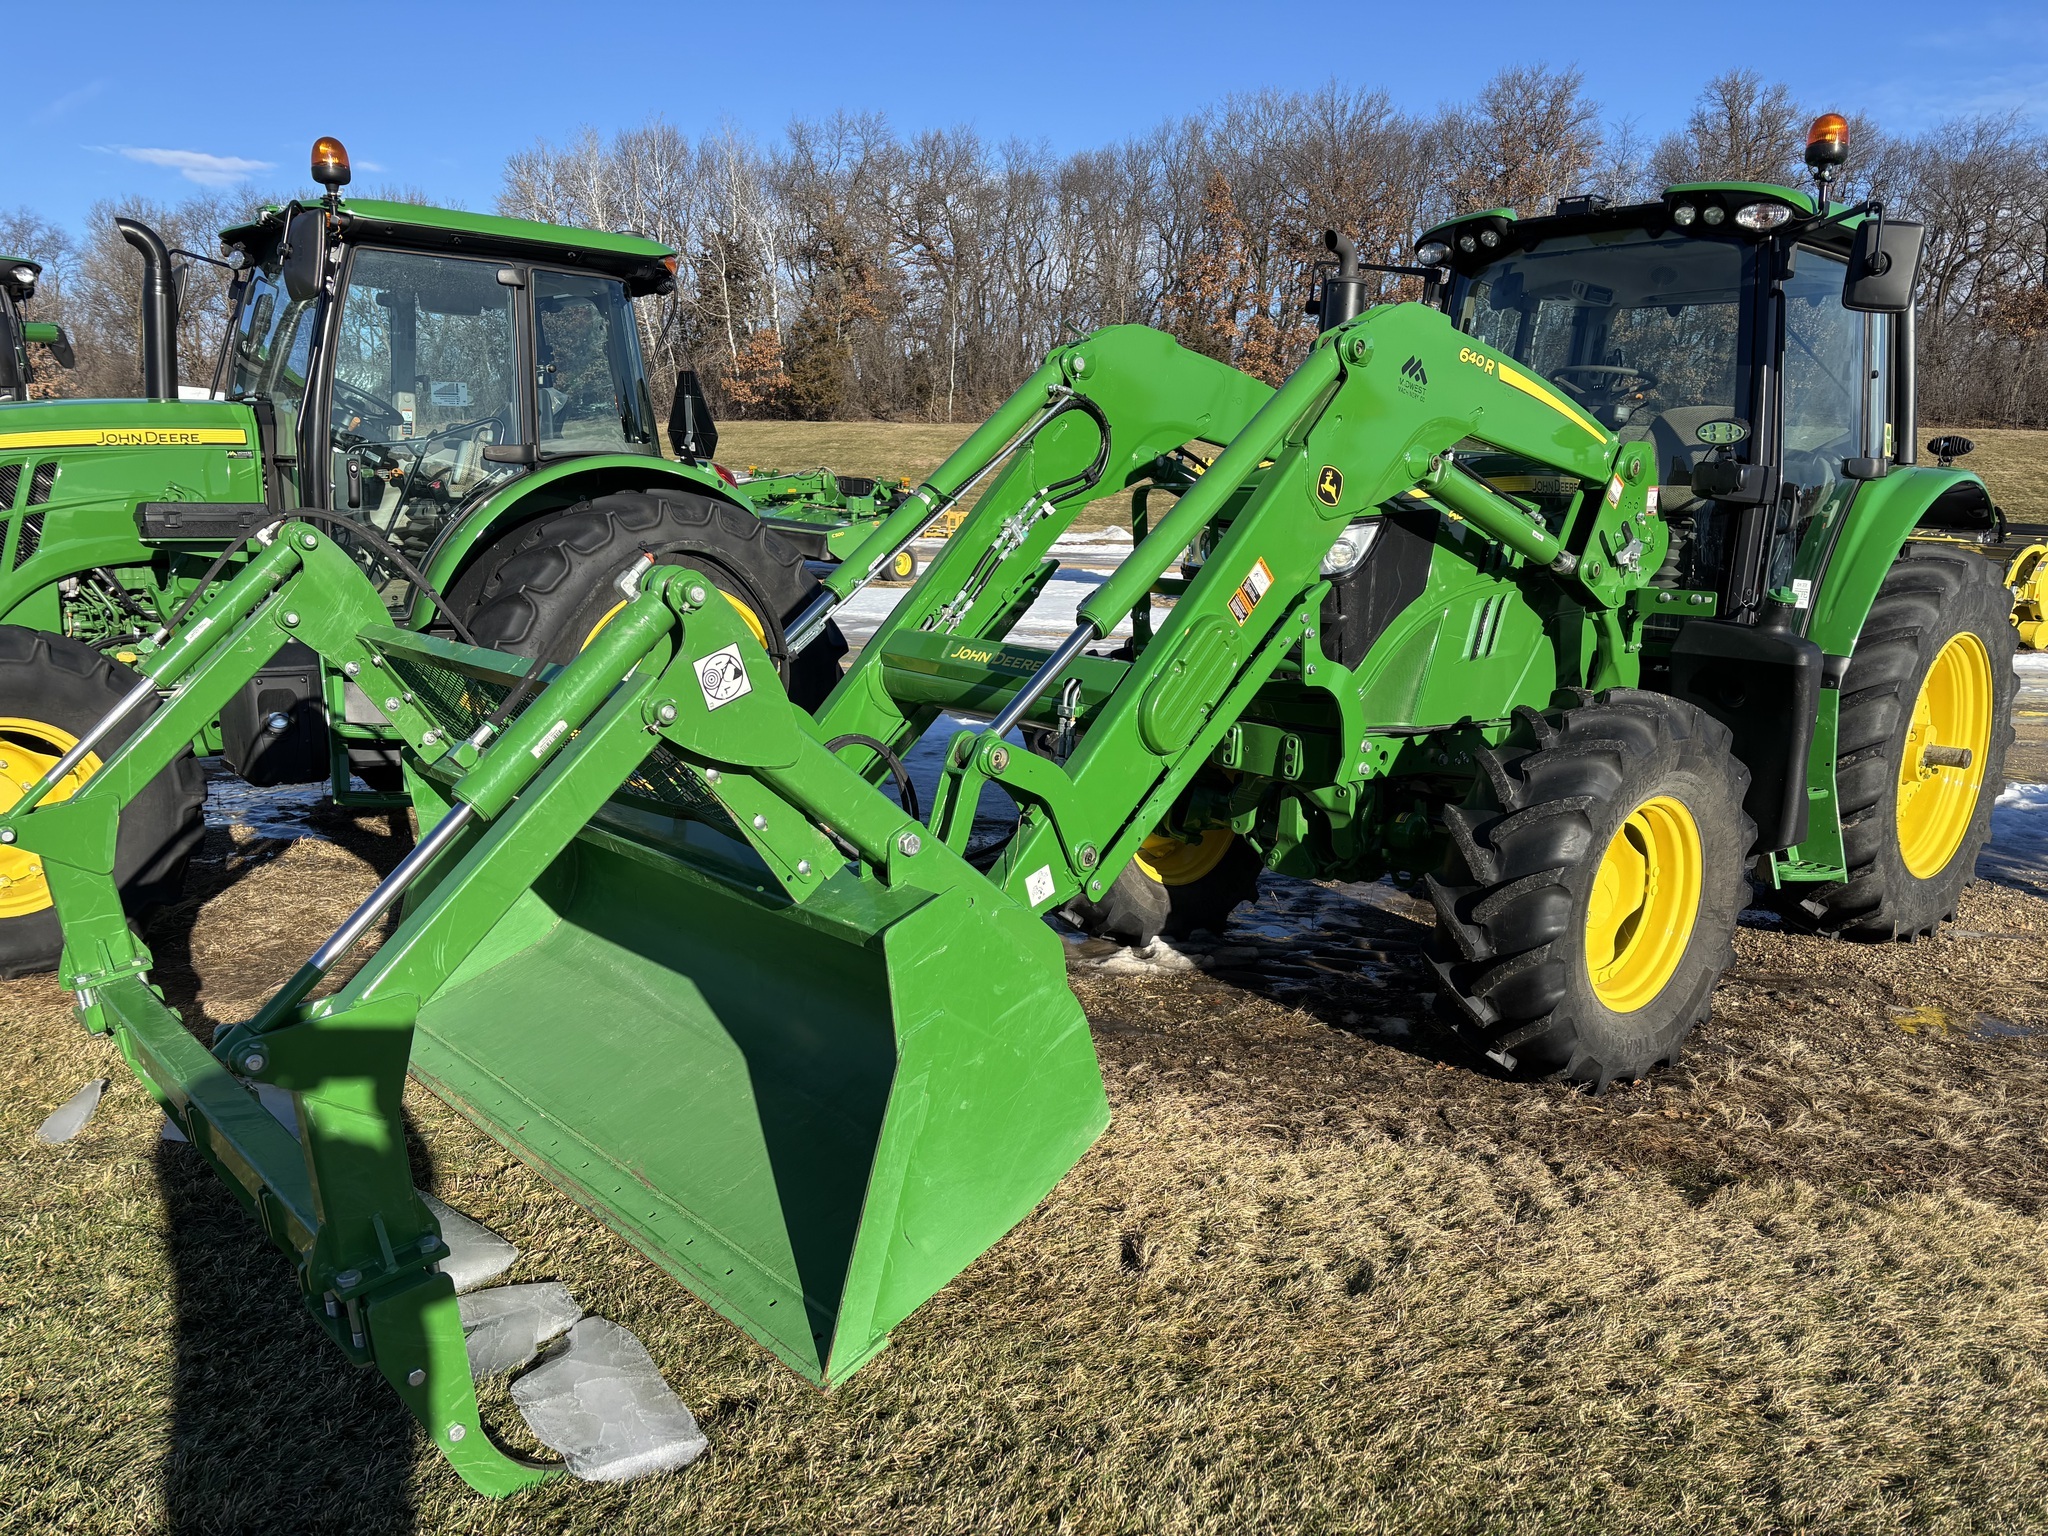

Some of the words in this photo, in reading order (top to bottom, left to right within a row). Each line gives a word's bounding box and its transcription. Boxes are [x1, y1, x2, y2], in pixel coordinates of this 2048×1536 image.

[1459, 347, 1495, 376] 640R
[96, 431, 142, 444] JOHN
[145, 431, 200, 443] DEERE
[1532, 478, 1554, 493] JOHN
[1555, 479, 1578, 493] DEERE
[950, 646, 993, 664] JOHN
[991, 652, 1044, 672] DEERE
